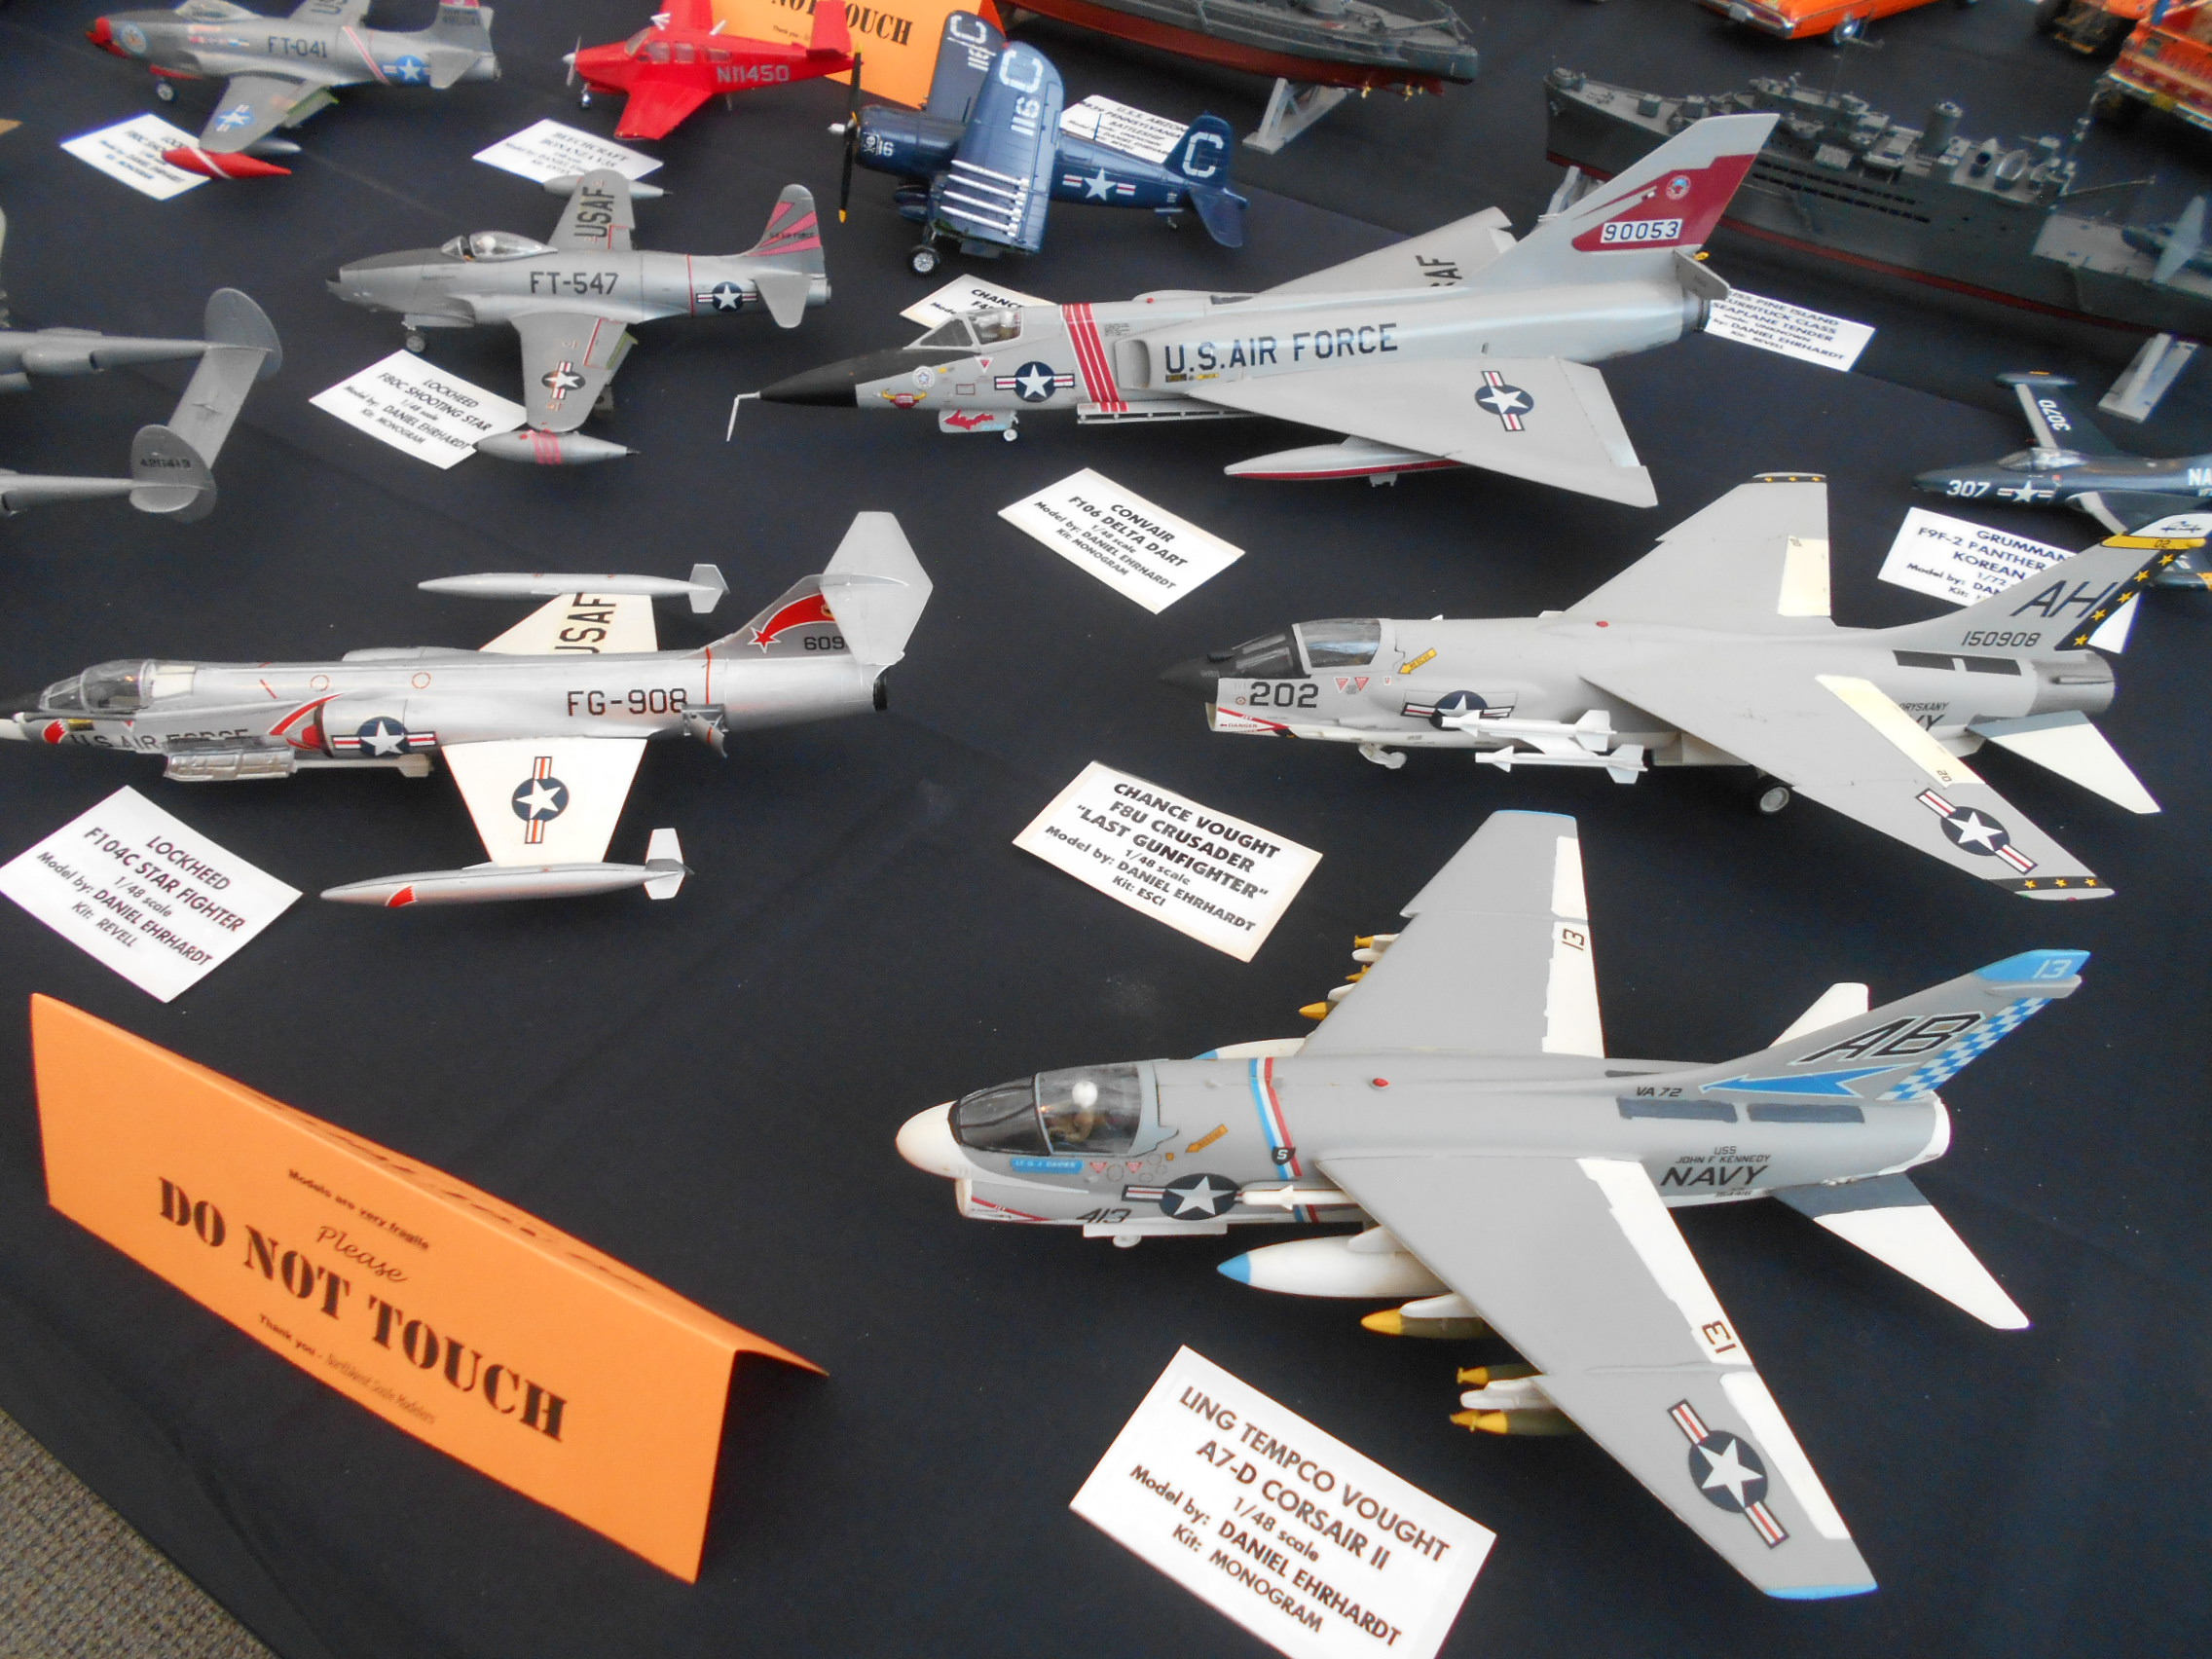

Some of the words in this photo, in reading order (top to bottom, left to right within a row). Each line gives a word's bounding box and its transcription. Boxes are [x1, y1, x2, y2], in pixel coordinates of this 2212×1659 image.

[846, 3, 913, 46] OUCH
[950, 15, 986, 44] C
[268, 36, 327, 58] FT-041
[717, 64, 790, 83] N11450
[999, 50, 1043, 92] C
[1011, 96, 1041, 136] 116
[553, 131, 630, 162] BEECHCRAFT
[1183, 131, 1224, 178] C
[573, 186, 615, 239] USAF
[1604, 220, 1679, 241] 90053
[530, 272, 619, 295] FT-547
[1416, 255, 1462, 286] AF
[972, 289, 1024, 308] CHANC
[1725, 299, 1791, 321] URRITUCK
[1795, 318, 1838, 335] CLASS
[1756, 299, 1786, 311] PINE
[1790, 309, 1839, 326] ISLAND
[1713, 302, 1782, 324] SEAPLANE
[1783, 323, 1834, 342] TENDER
[1731, 322, 1775, 339] DANIEL
[1779, 337, 1845, 360] EHRHARDT
[1293, 323, 1398, 361] FORCE
[404, 387, 462, 419] SHOOTING
[461, 415, 494, 432] STAR
[424, 379, 480, 409] LOCKHEED
[377, 414, 427, 445] MONOGRAM
[383, 404, 419, 426] DANIEL
[418, 422, 471, 451] EHRHARDT
[1947, 480, 1991, 498] 307
[1068, 496, 1101, 518] F106
[1101, 516, 1146, 545] DELTA
[1145, 541, 1188, 567] DART
[1089, 524, 1113, 540] 1/48
[1112, 537, 1137, 554] scale
[1111, 503, 1176, 542] CONVAIR
[1034, 500, 1067, 527] Model
[1067, 520, 1083, 534] by:
[1082, 531, 1120, 556] DANIEL
[1119, 553, 1177, 590] EHRHARDT
[1072, 537, 1129, 576] MONOGRAM
[1918, 527, 1964, 546] F9F-2
[1968, 540, 2047, 571] PANTHER
[1976, 530, 2072, 562] GRUMMAN
[2155, 538, 2172, 549] 02
[1906, 562, 1945, 578] Model
[1947, 572, 1967, 586] by:
[1953, 551, 2027, 580] KOREAN
[1977, 571, 2009, 586] 1/72
[1948, 586, 1970, 598] Kit:
[2009, 580, 2119, 618] AH
[804, 637, 846, 651] 609
[1962, 631, 2042, 647] 150908
[567, 688, 688, 717] FG-908
[1249, 682, 1319, 709] 202
[1109, 800, 1149, 825] F8U
[1151, 819, 1256, 873] CRUSADER
[1113, 783, 1194, 823] CHANCE
[1196, 815, 1281, 860] VOUGHT
[84, 827, 141, 866] F104C
[135, 861, 181, 894] STAR
[176, 887, 246, 933] FIGHTER
[146, 835, 232, 891] LOCKHEED
[1045, 825, 1092, 854] Model
[1092, 843, 1115, 866] by:
[1117, 861, 1170, 894] DANIEL
[1172, 887, 1257, 933] EHRHARDT
[1125, 848, 1157, 868] 1/48
[1156, 865, 1191, 886] scale
[37, 851, 74, 880] Model
[73, 874, 95, 895] by:
[93, 888, 141, 925] DANIEL
[141, 919, 214, 967] EHRHARDT
[114, 875, 143, 899] 1/48
[142, 895, 174, 919] scale
[1113, 874, 1136, 893] Kit:
[1136, 887, 1167, 907] ESCI
[71, 901, 95, 921] Kit:
[95, 917, 140, 948] REVELL
[1562, 928, 1585, 951] 13
[2033, 960, 2073, 979] 13
[1789, 1012, 1984, 1064] AB
[1636, 1087, 1655, 1097] VA
[1658, 1088, 1682, 1097] 72
[1676, 1156, 1706, 1164] JOHN
[1719, 1154, 1772, 1163] KENNEDY
[1714, 1146, 1737, 1156] USS
[1660, 1165, 1769, 1187] NAVY
[289, 1167, 332, 1199] Models
[335, 1194, 357, 1211] are
[359, 1206, 390, 1231] very
[388, 1220, 430, 1252] fragile
[1076, 1207, 1133, 1225] 413
[316, 1224, 409, 1284] Please
[159, 1175, 227, 1248] DO
[243, 1224, 351, 1321] NOT
[368, 1293, 569, 1444] TOUCH
[259, 1313, 293, 1341] Thank
[294, 1334, 317, 1358] you
[1702, 1319, 1737, 1354] 13
[1179, 1385, 1236, 1432] LING
[1239, 1421, 1337, 1493] TEMPCO
[1342, 1482, 1451, 1564] VOUGHT
[1196, 1439, 1258, 1487] A7-D
[1262, 1479, 1369, 1558] CORSAIR
[1369, 1544, 1392, 1571] II
[1232, 1495, 1276, 1533] 1/48
[1277, 1528, 1320, 1563] scale
[1129, 1462, 1185, 1505] Model
[1184, 1494, 1212, 1527] by:
[1218, 1519, 1289, 1578] DANIEL
[1292, 1568, 1403, 1647] EHRHARDT
[1171, 1522, 1204, 1554] Kit:
[1208, 1548, 1325, 1635] MONOGRAM
